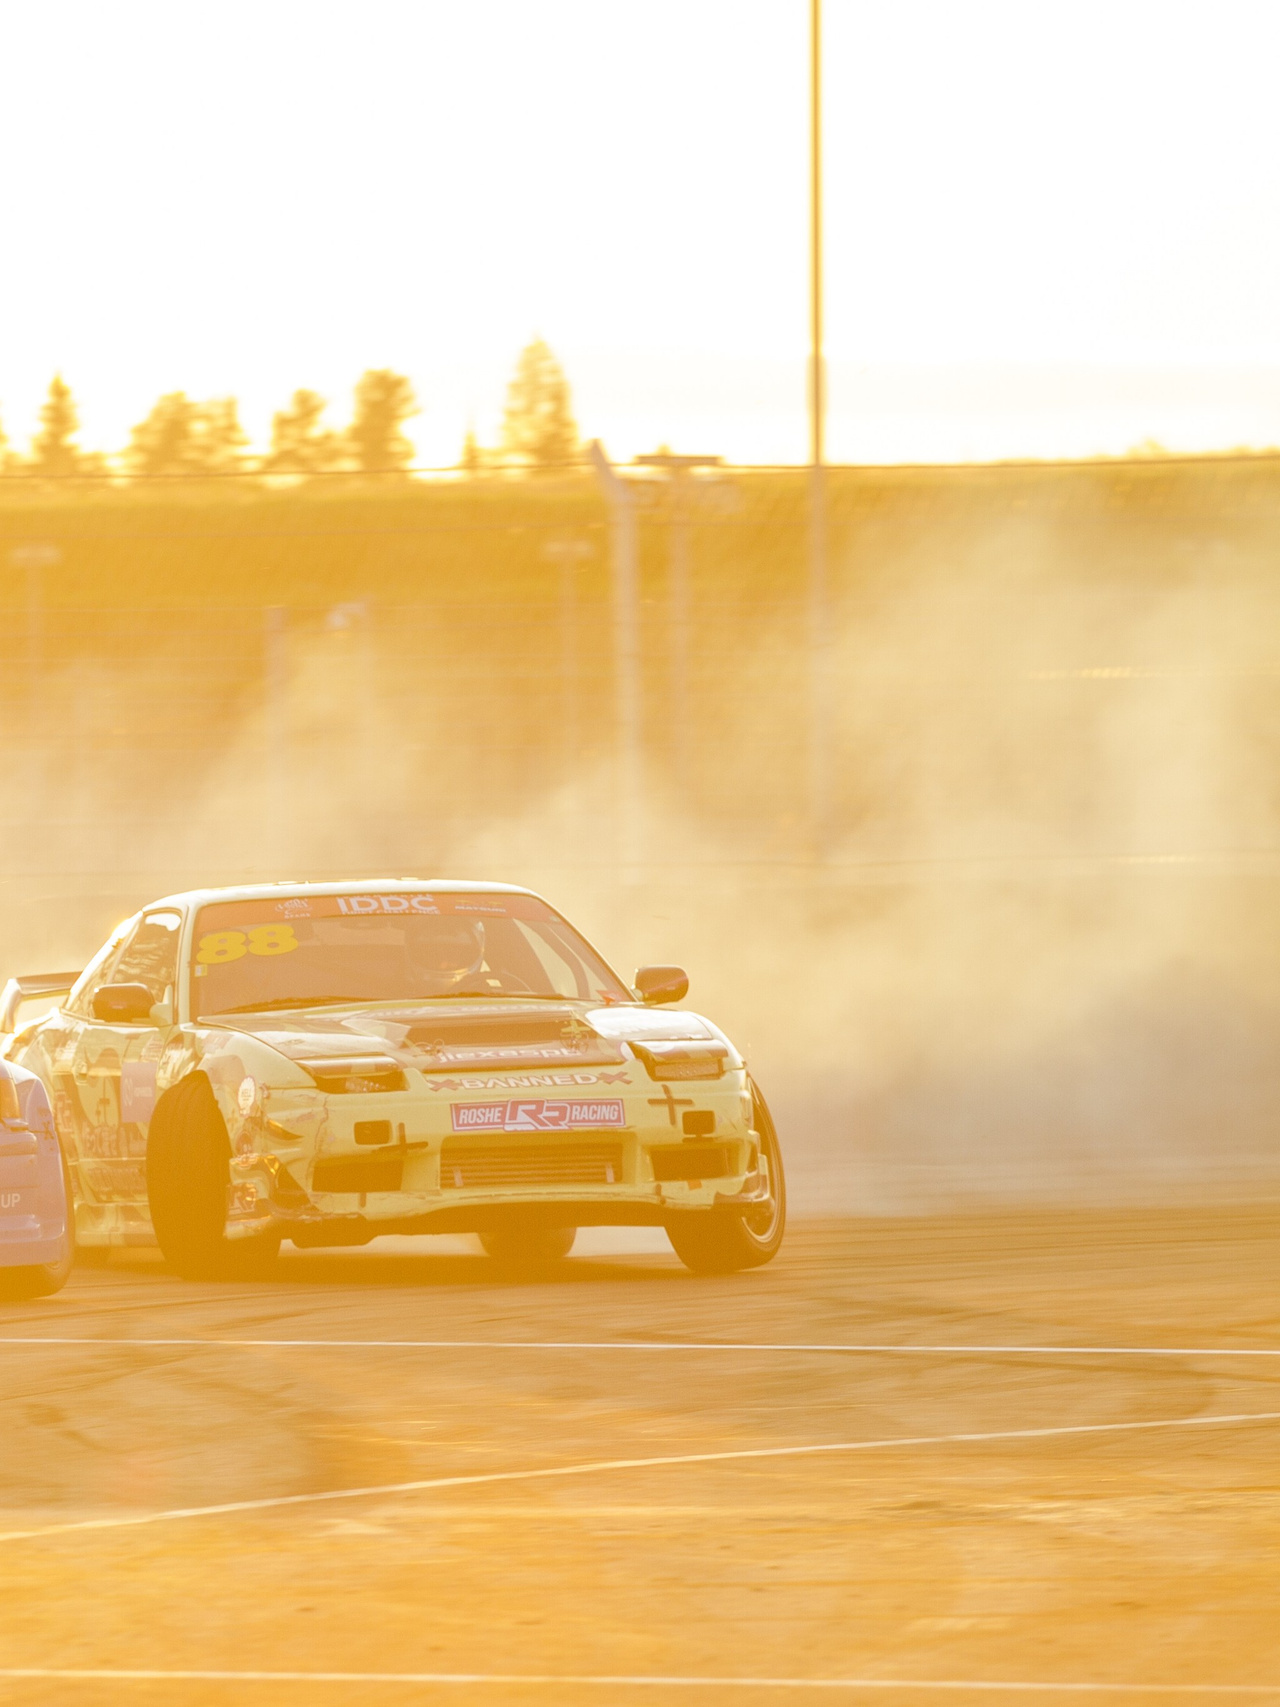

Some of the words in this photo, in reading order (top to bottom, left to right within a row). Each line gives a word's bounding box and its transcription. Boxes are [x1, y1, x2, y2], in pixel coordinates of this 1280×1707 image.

[336, 896, 439, 913] IDDC
[195, 923, 299, 964] 88
[461, 1074, 598, 1089] BANNED
[459, 1107, 503, 1124] ROSHE
[571, 1105, 619, 1121] RACING
